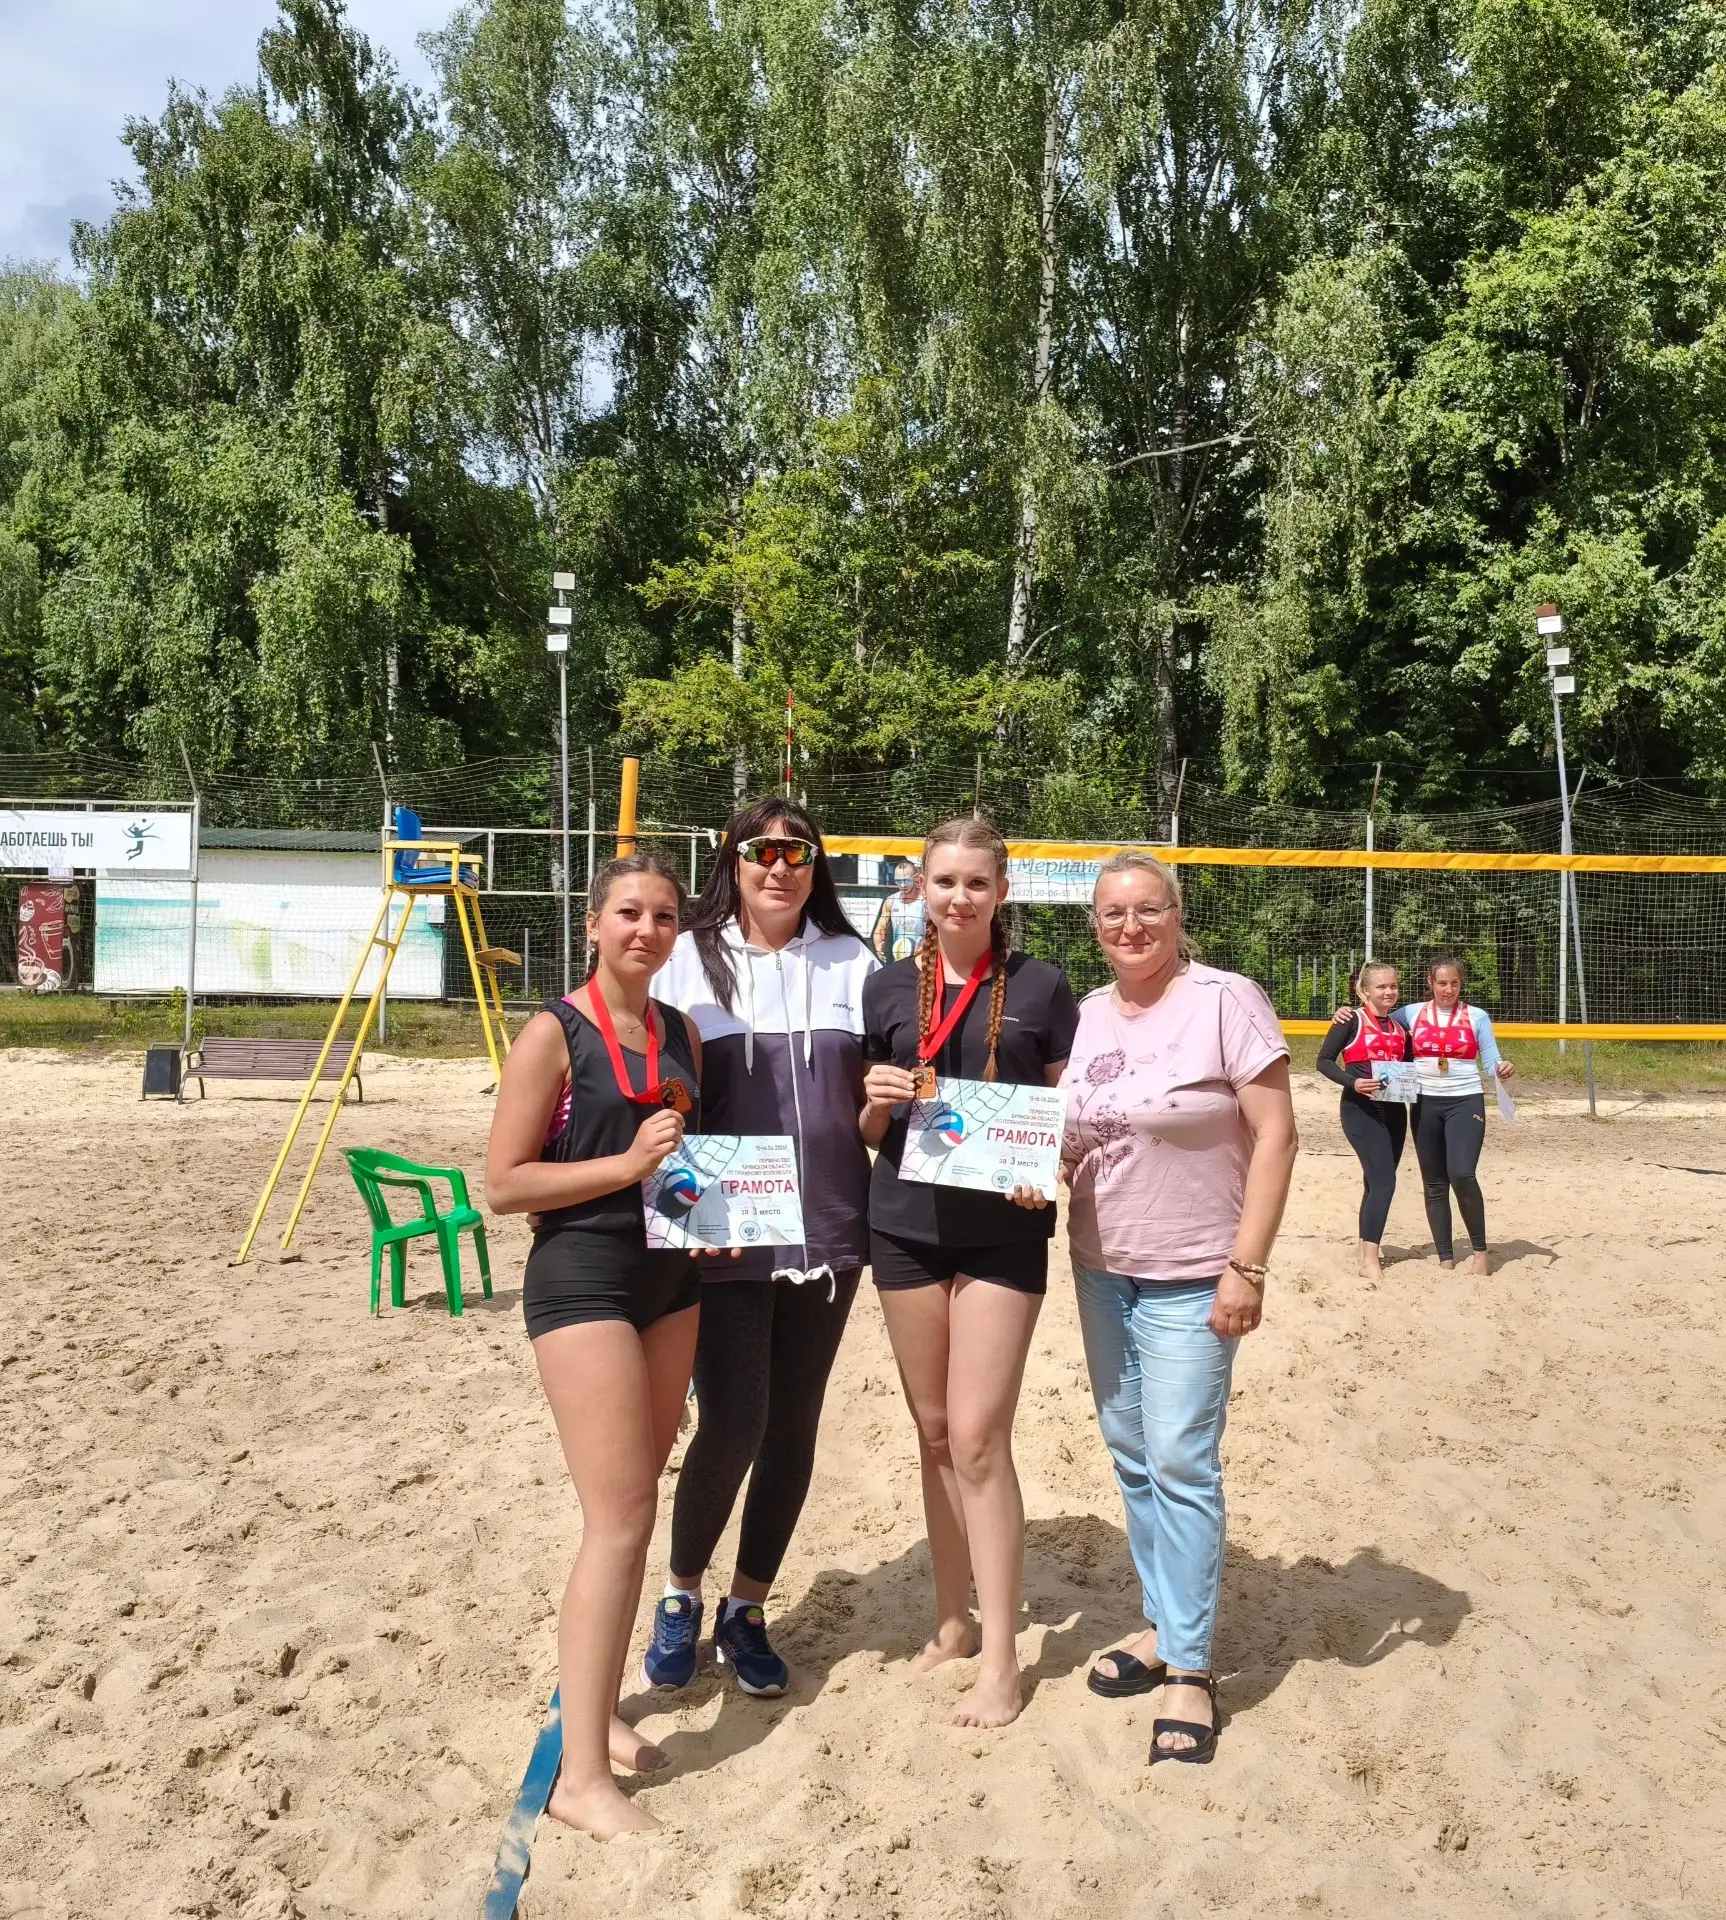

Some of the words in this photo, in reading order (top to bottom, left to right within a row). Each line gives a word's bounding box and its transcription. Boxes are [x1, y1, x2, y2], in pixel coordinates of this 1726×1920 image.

[0, 831, 68, 847] АБОТАЕШЬ
[71, 832, 94, 848] ТЫ!
[1458, 1029, 1469, 1043] 1
[986, 1127, 1057, 1148] ГРАМОТА
[1010, 1156, 1016, 1166] 3
[1017, 1160, 1039, 1168] место
[720, 1179, 795, 1194] ГРАМОТА
[752, 1206, 758, 1216] 3
